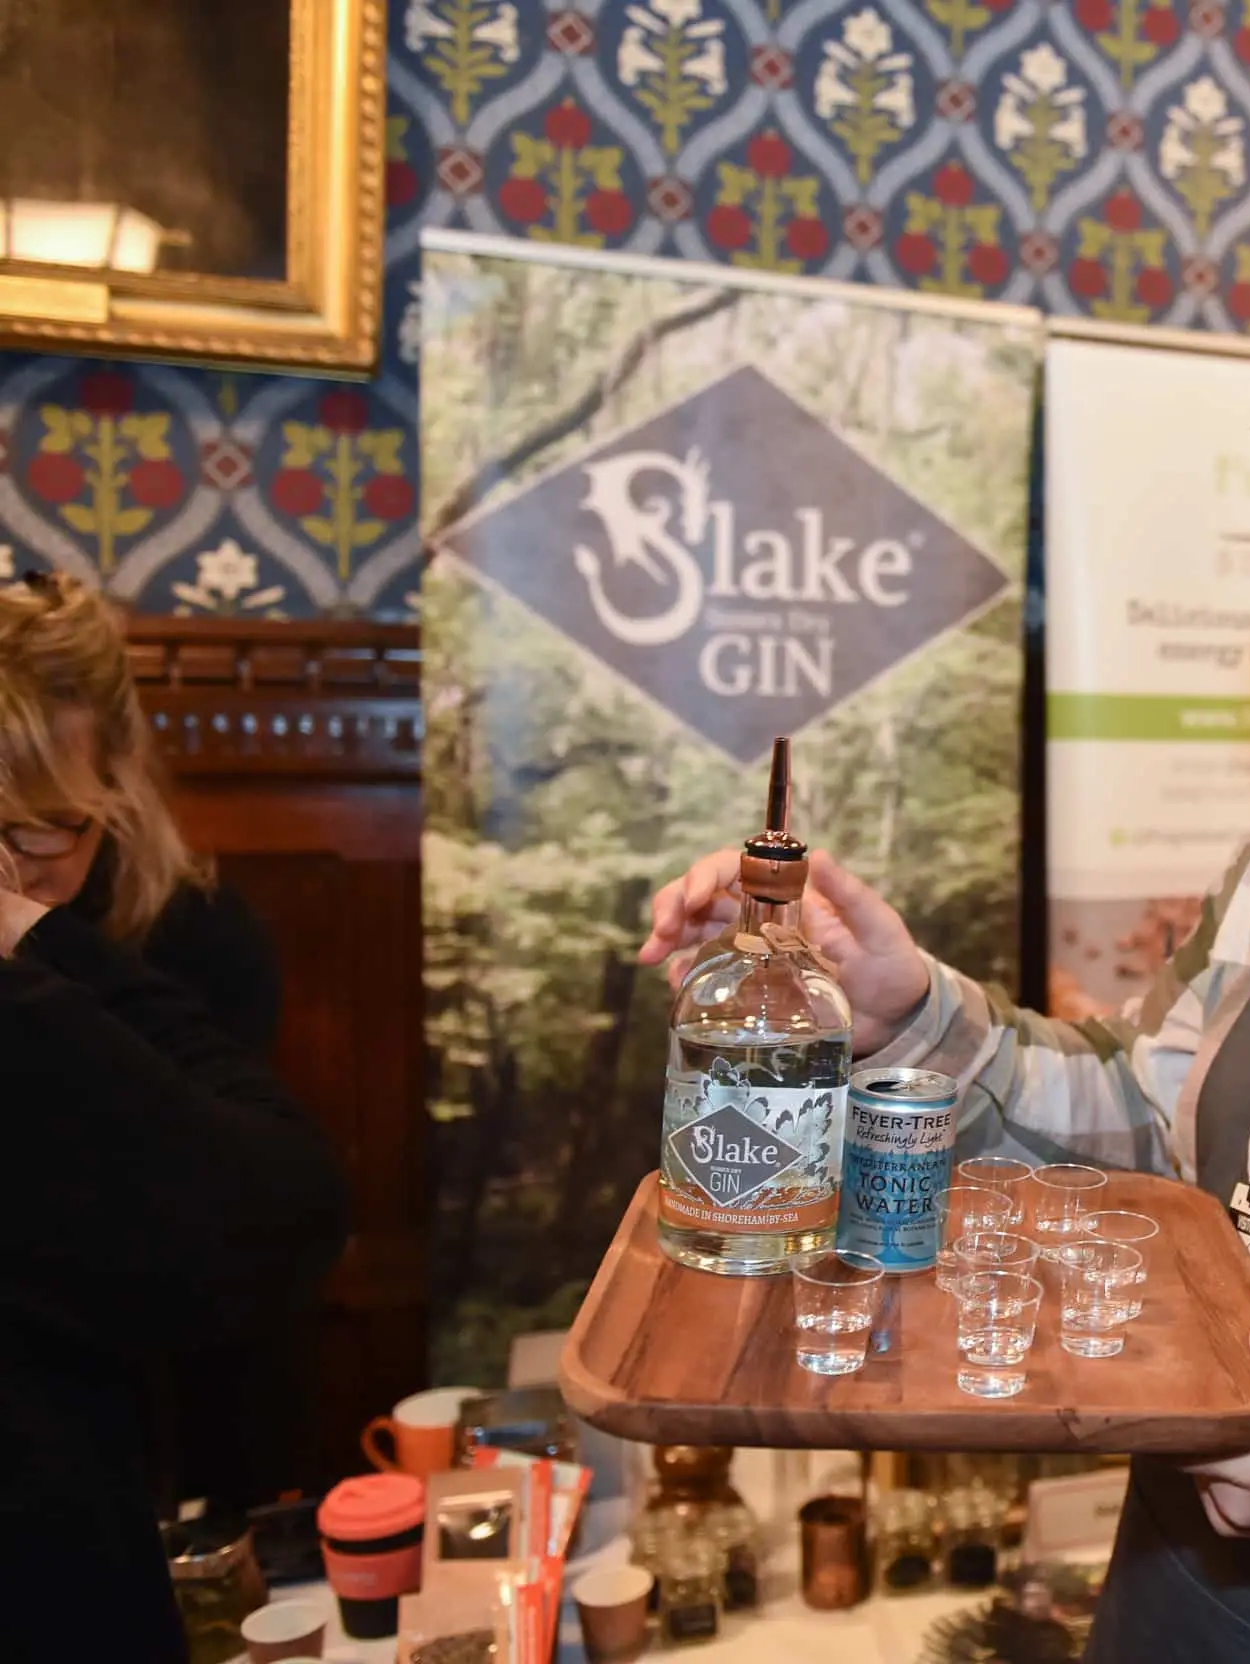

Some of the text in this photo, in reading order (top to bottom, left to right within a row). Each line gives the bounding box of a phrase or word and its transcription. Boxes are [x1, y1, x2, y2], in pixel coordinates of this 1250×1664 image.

[573, 445, 914, 647] Slake
[700, 633, 834, 697] GIN
[852, 1106, 951, 1130] FEVER-TREE
[690, 1125, 778, 1164] Slake
[856, 1125, 943, 1149] Refreshingly Light
[710, 1172, 741, 1194] GIN
[860, 1172, 931, 1193] TONIC
[701, 1208, 711, 1220] IN
[856, 1192, 932, 1214] WATER
